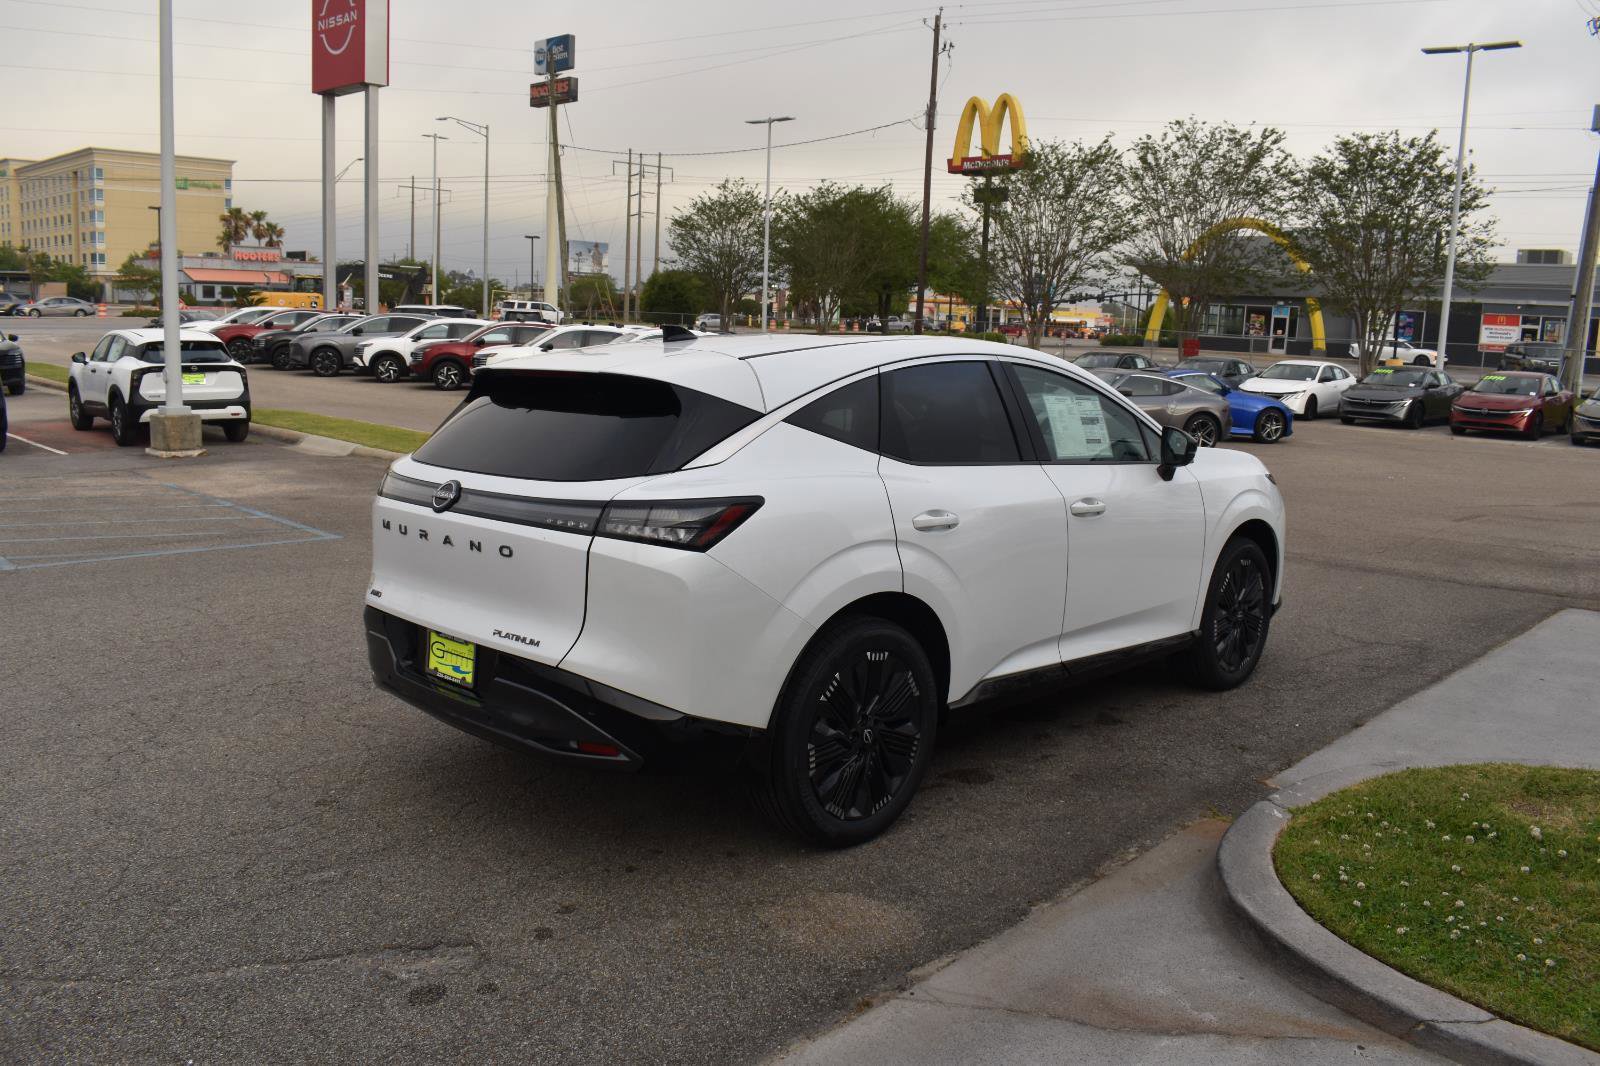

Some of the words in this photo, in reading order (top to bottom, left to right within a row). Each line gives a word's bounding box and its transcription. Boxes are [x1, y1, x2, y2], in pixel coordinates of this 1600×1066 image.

[318, 9, 357, 31] NISSAN
[962, 159, 1009, 170] McDonald's
[234, 249, 281, 262] HOOTERS
[382, 518, 514, 558] MURANO
[492, 628, 541, 648] PLATINUM
